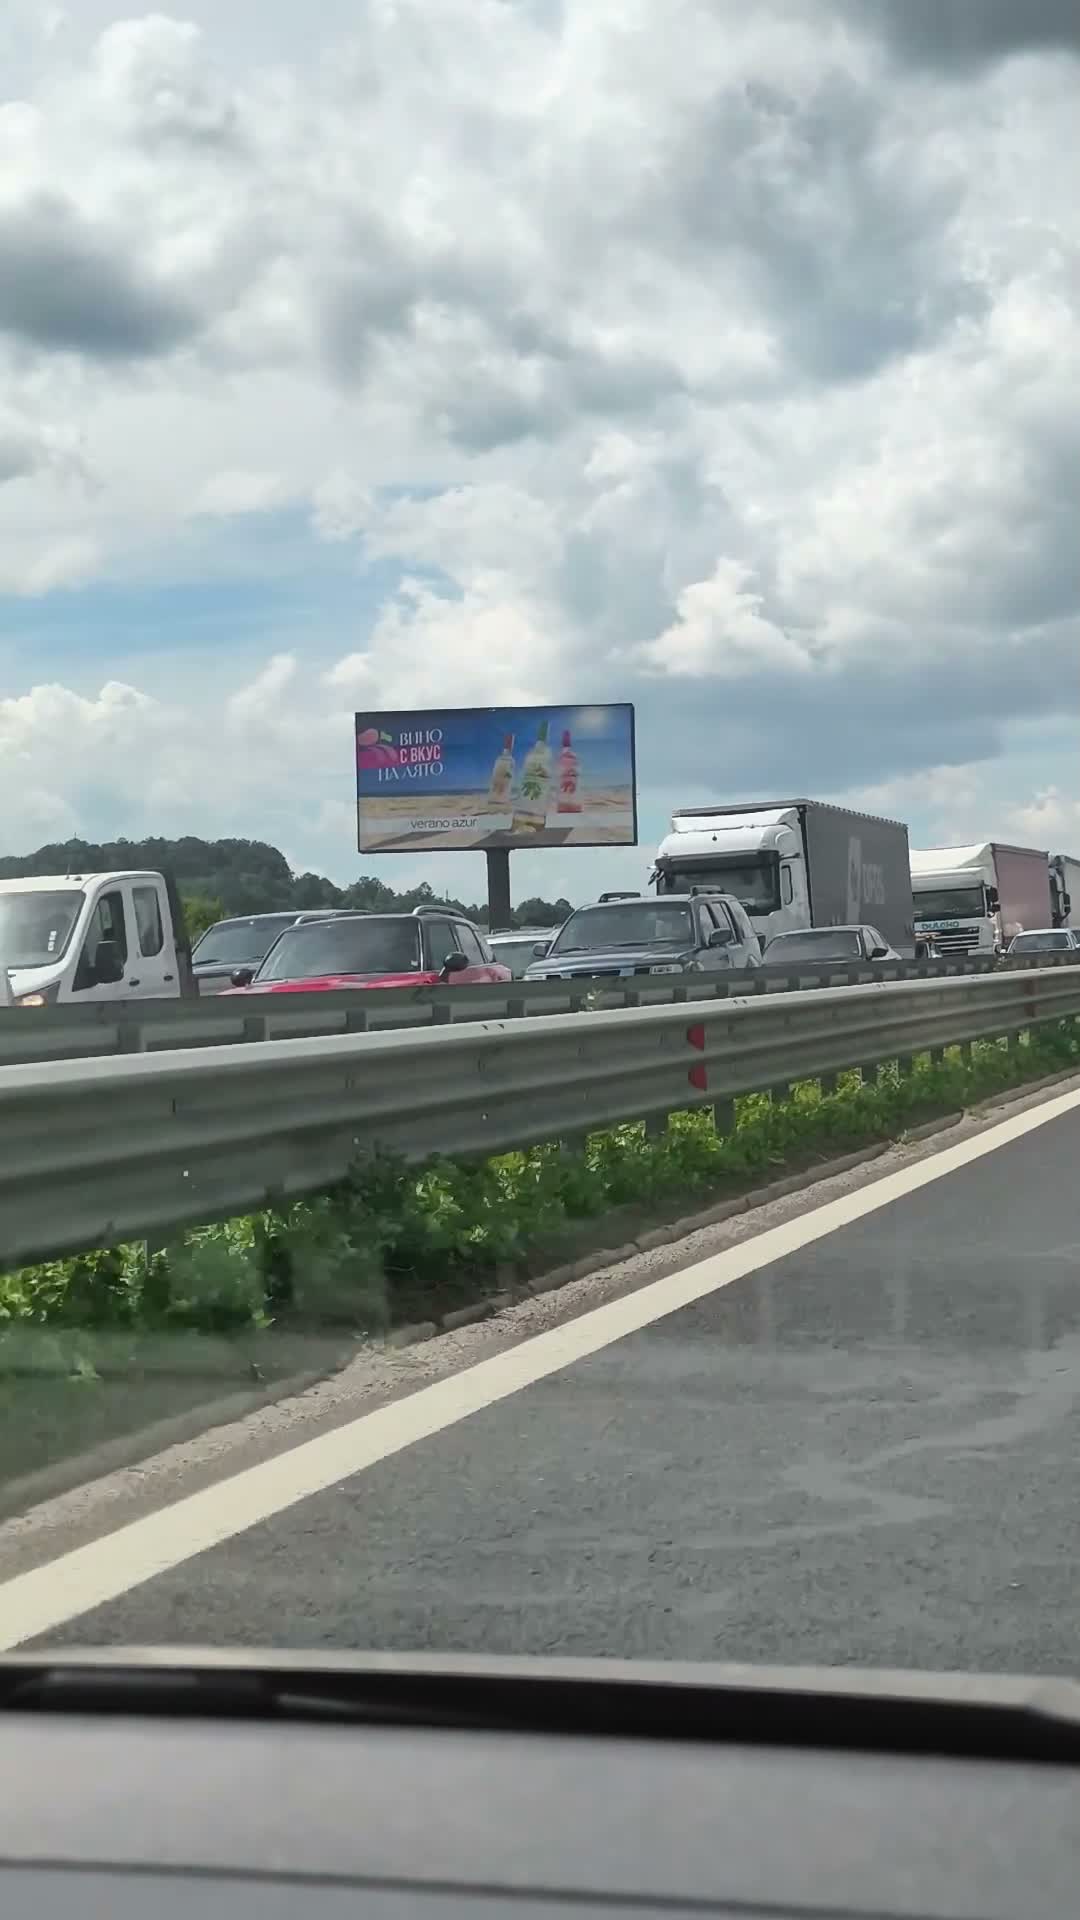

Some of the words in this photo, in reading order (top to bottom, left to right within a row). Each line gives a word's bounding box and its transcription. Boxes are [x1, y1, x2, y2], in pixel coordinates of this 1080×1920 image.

[400, 729, 442, 746] ВИНО
[400, 749, 408, 764] С
[411, 745, 441, 763] ВКУС
[378, 768, 400, 782] НА
[402, 762, 444, 778] ЛЯТО
[410, 819, 450, 829] verano
[452, 818, 478, 828] azur
